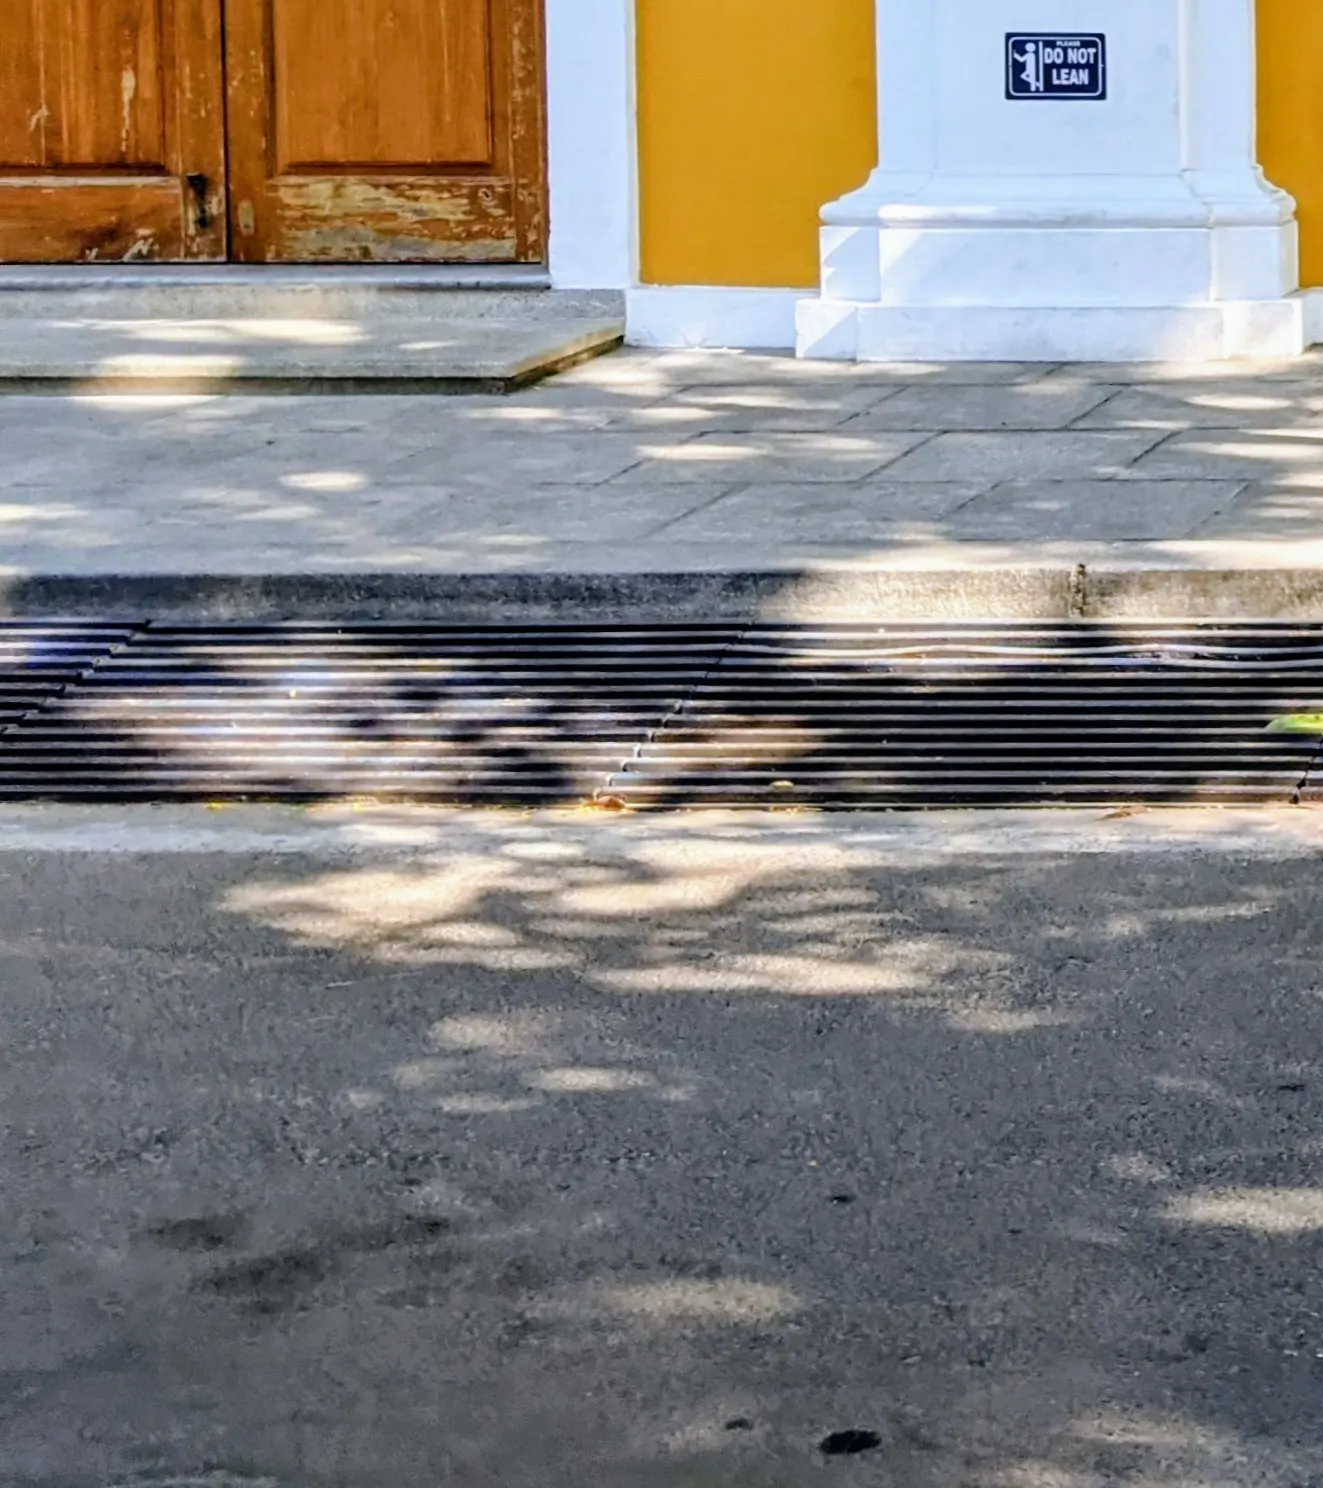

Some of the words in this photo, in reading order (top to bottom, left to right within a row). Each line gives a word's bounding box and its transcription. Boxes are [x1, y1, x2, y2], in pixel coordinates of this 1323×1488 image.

[1044, 47, 1064, 64] DO
[1067, 47, 1097, 64] NOT
[1052, 68, 1089, 85] LEAN
